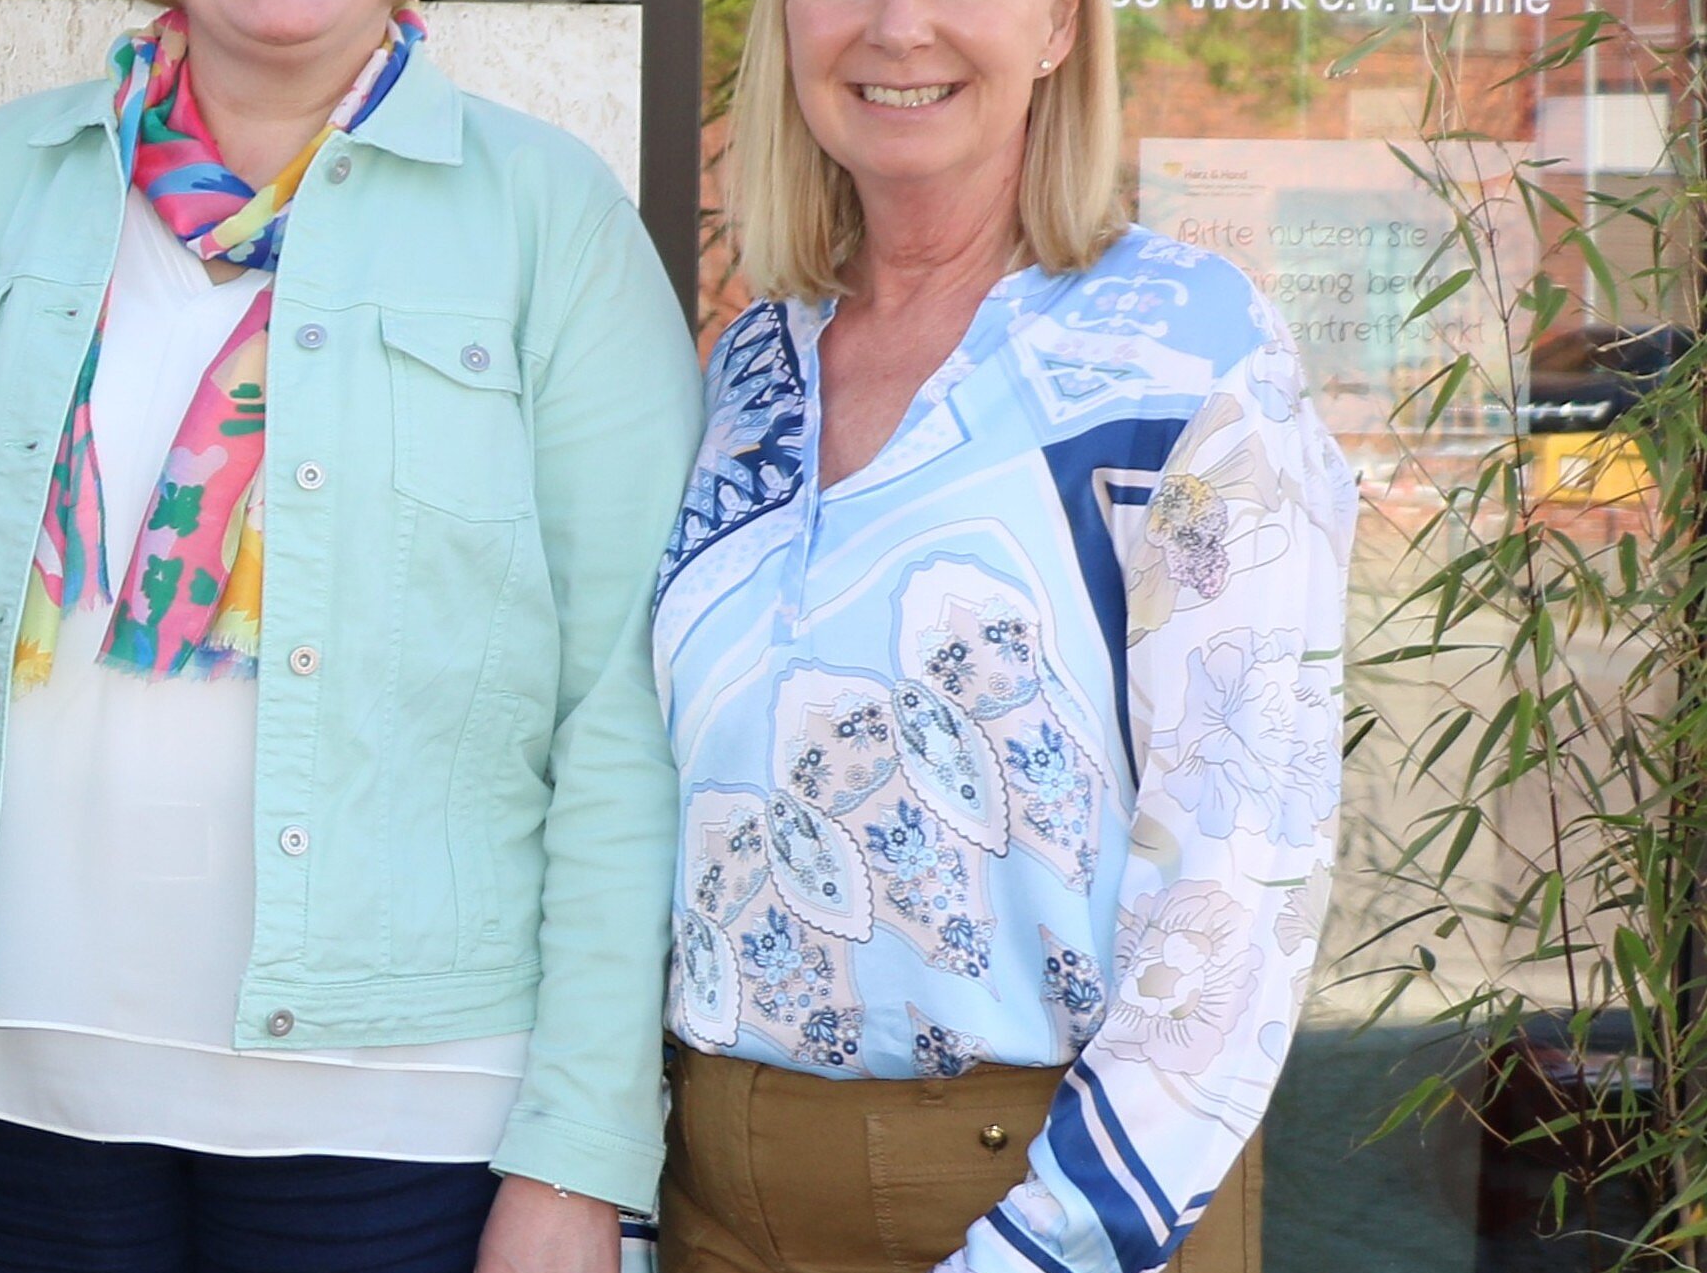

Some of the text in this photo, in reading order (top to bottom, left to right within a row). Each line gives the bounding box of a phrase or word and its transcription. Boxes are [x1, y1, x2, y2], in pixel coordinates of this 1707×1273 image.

[1178, 217, 1253, 248] Bitte
[1268, 219, 1373, 248] nutzen
[1388, 220, 1428, 248] Sie
